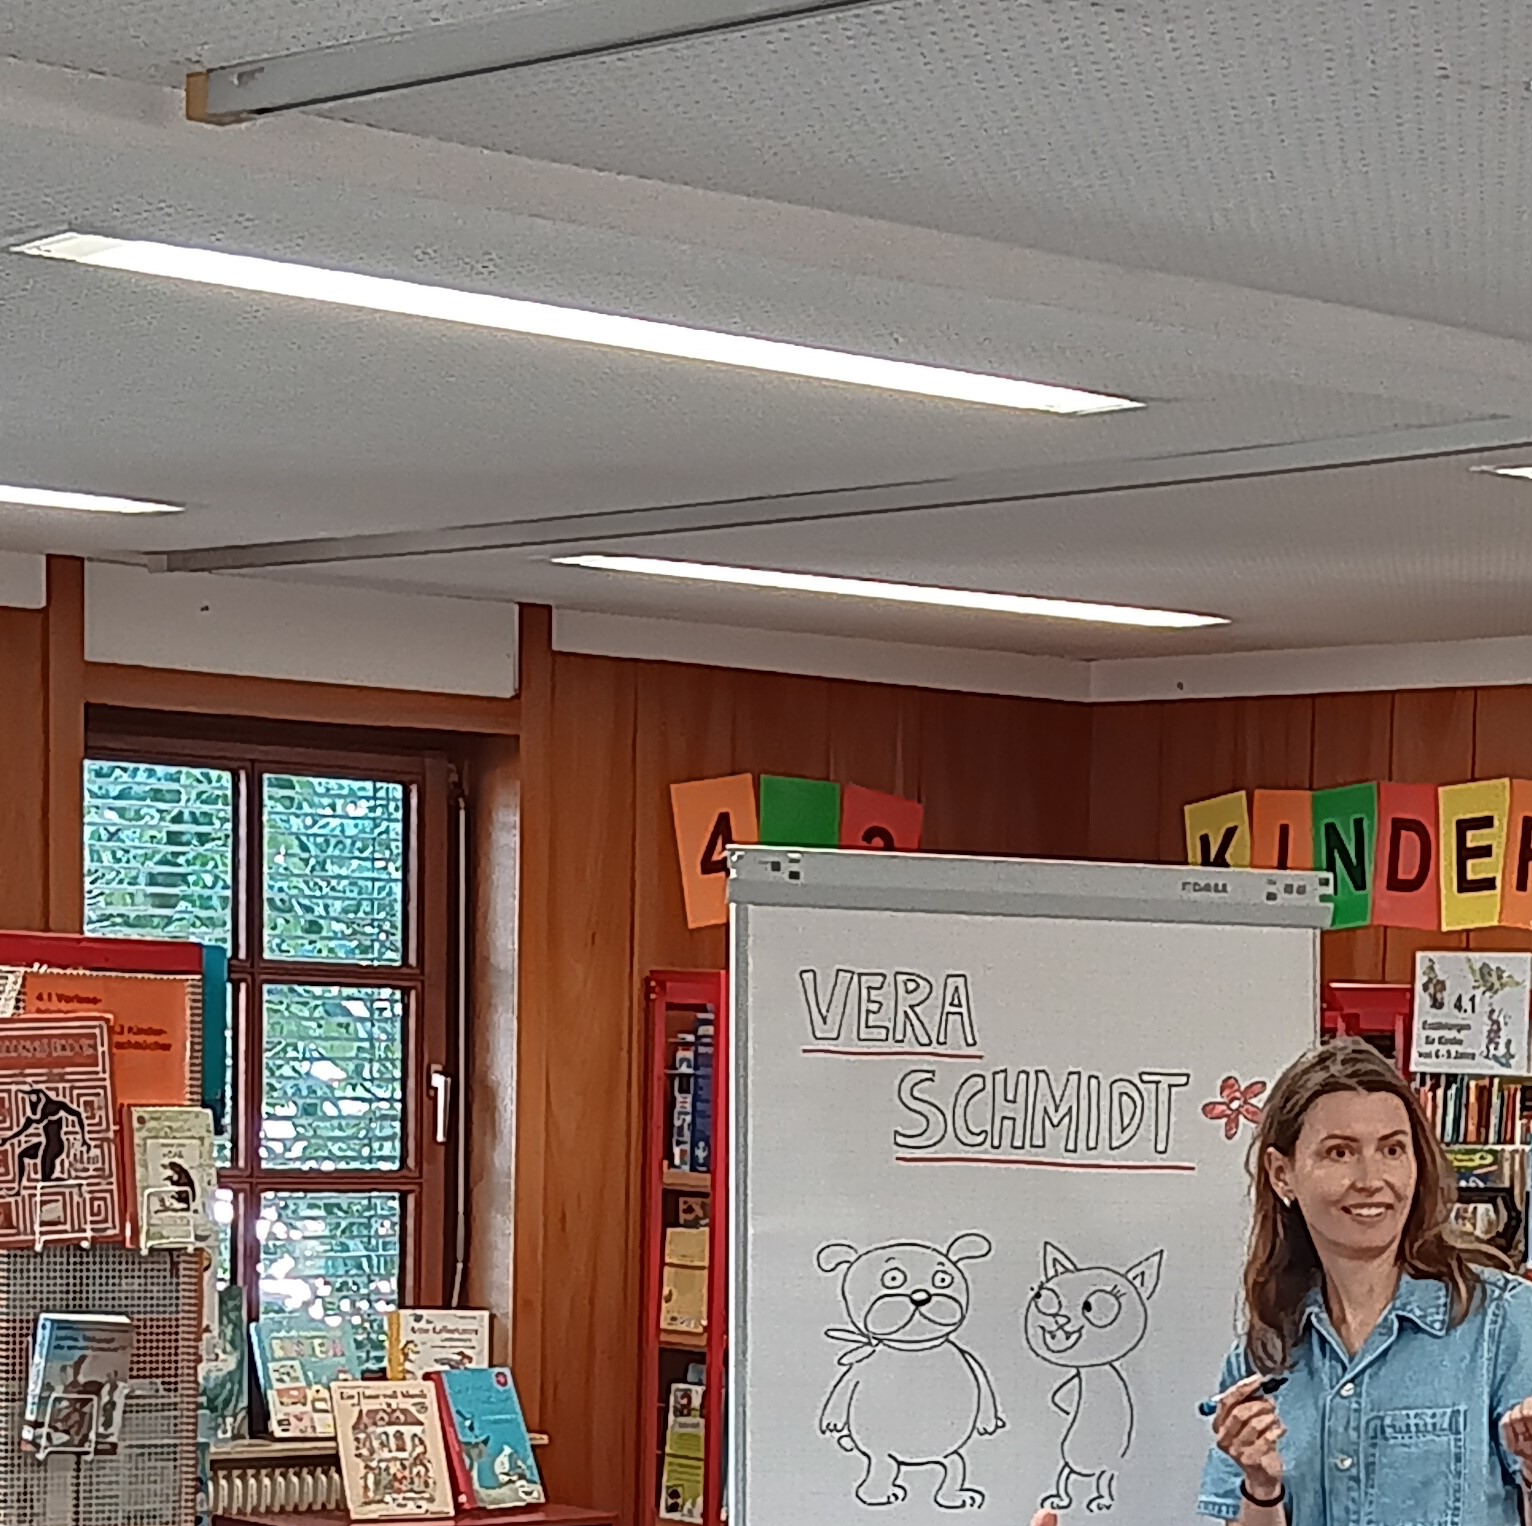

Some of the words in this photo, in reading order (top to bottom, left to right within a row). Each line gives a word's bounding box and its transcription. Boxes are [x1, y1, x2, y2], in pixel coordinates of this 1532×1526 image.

[799, 968, 977, 1047] VERA
[1454, 993, 1476, 1014] 4.1
[893, 1067, 1190, 1155] SCHMIDT
